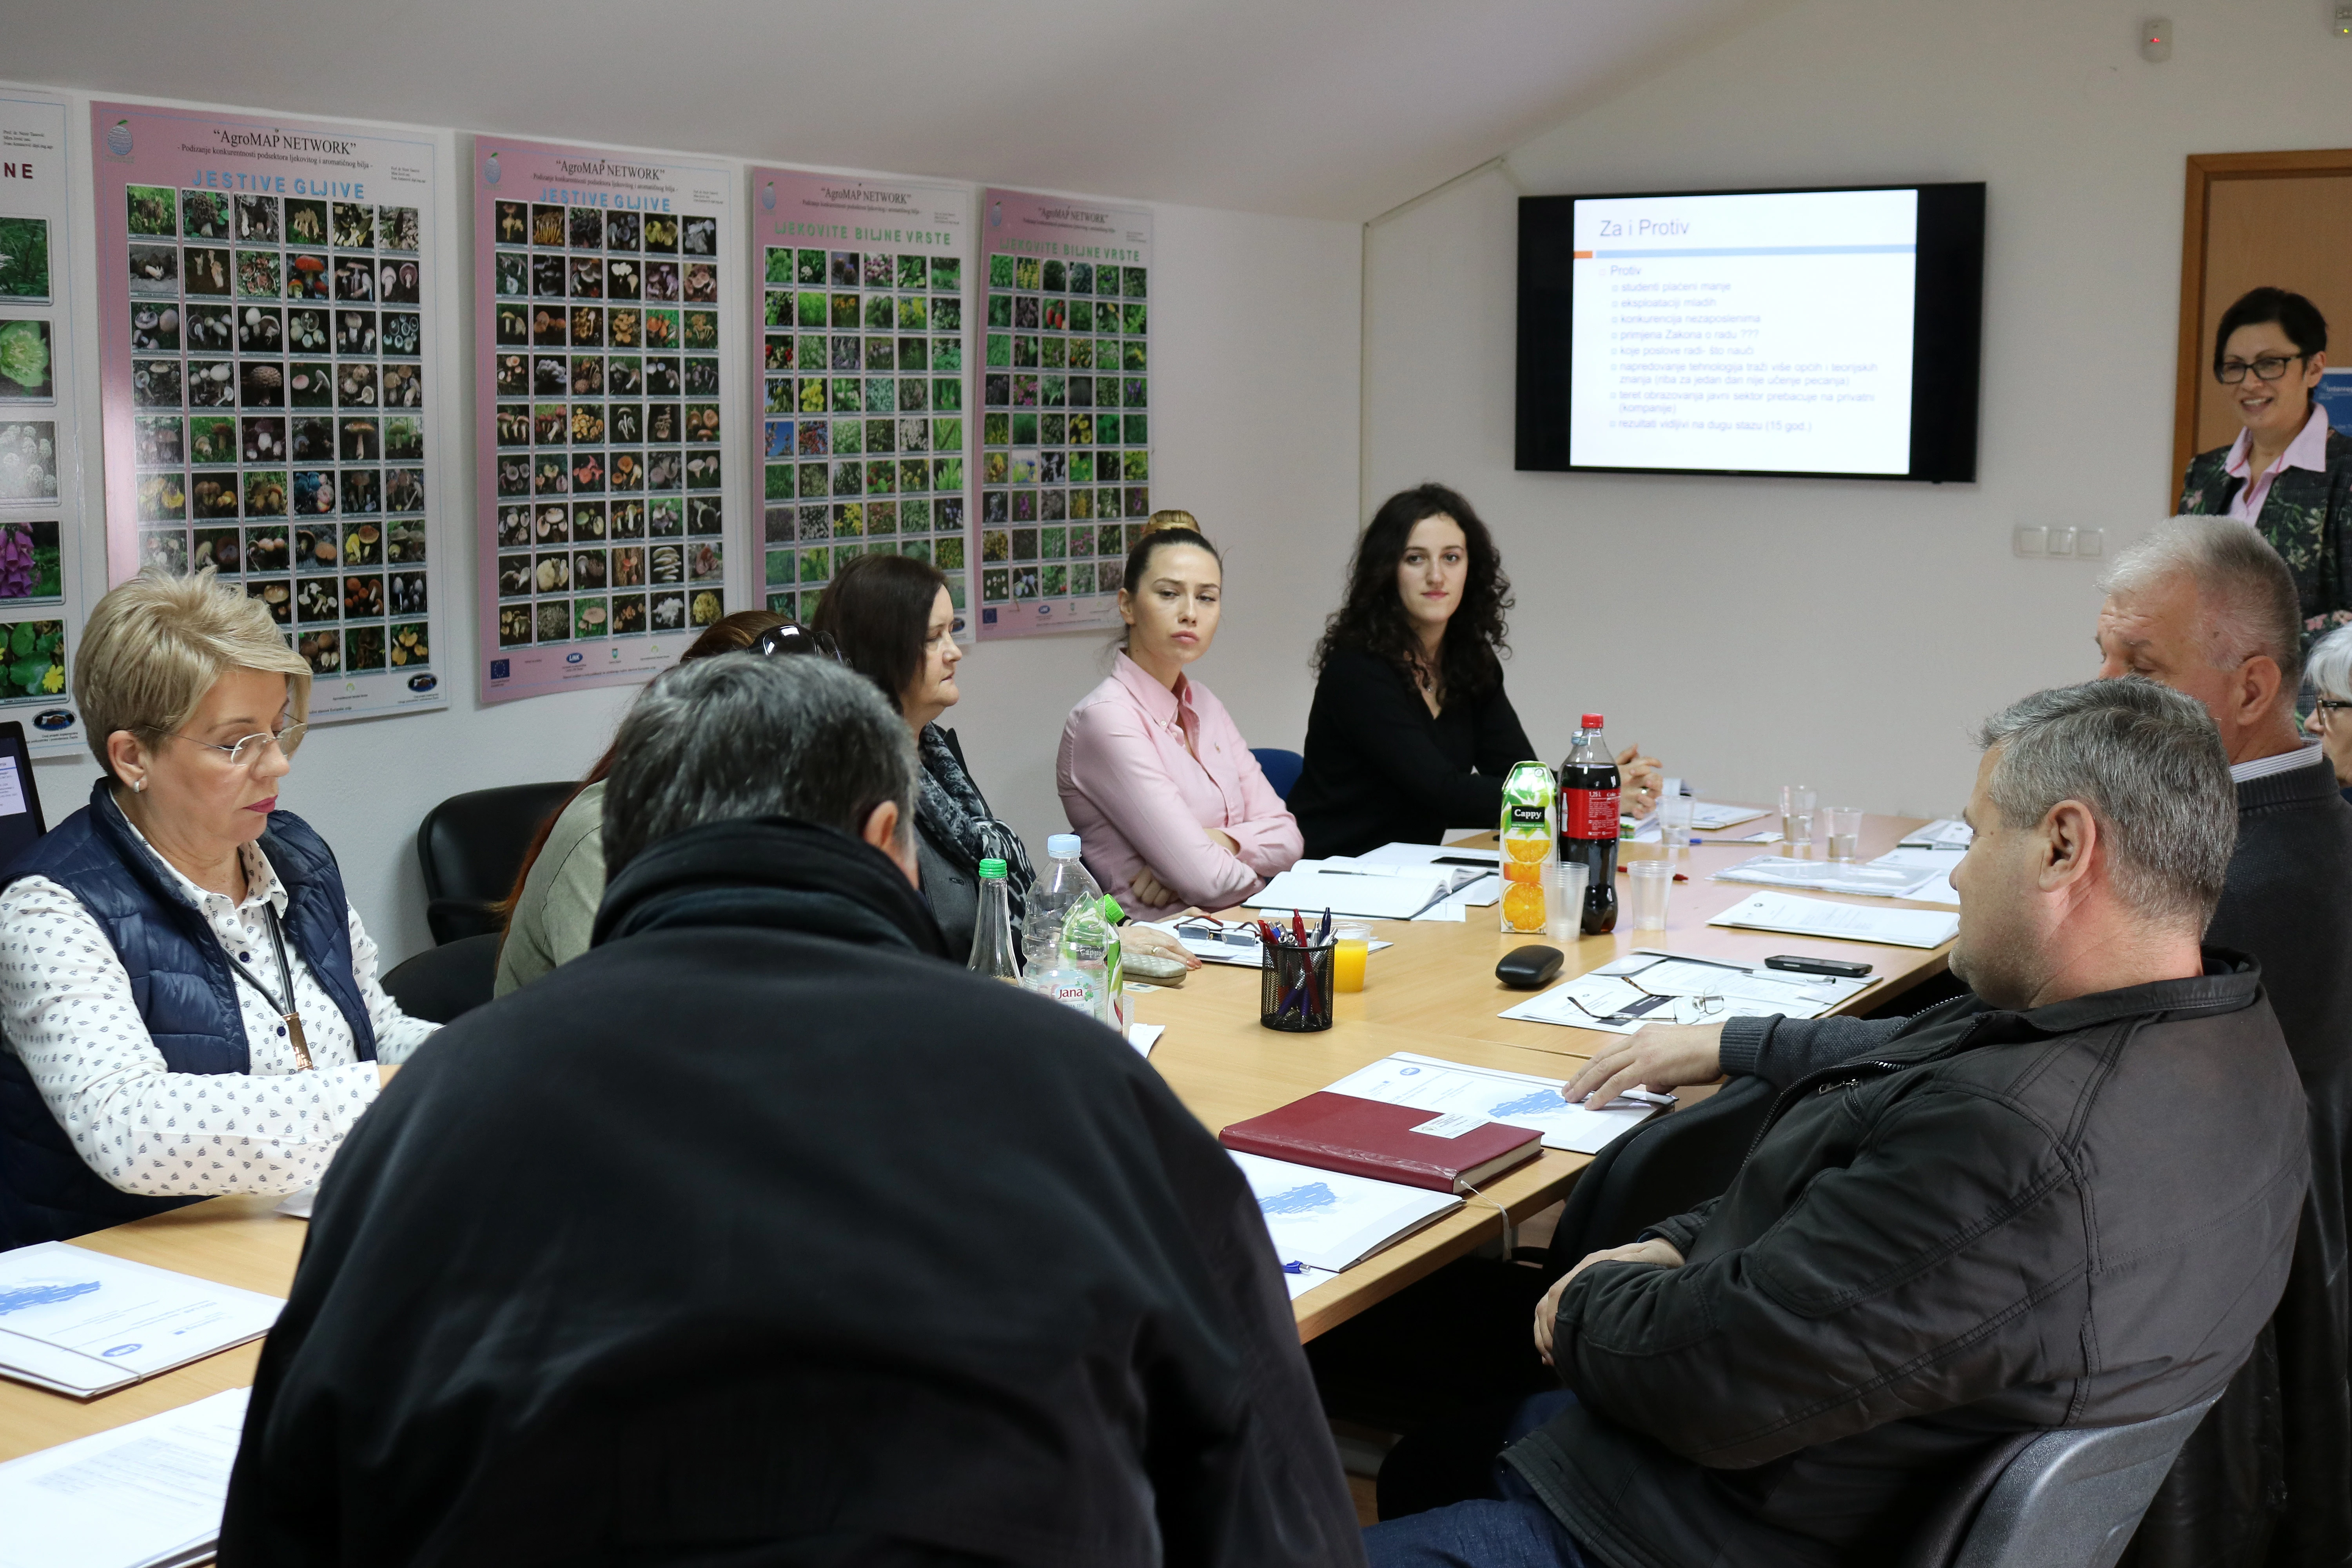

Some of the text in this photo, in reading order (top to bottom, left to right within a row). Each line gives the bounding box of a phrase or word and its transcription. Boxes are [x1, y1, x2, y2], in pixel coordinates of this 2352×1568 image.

[181, 144, 211, 155] Podizanje
[213, 147, 256, 157] konkurentnosti
[257, 152, 288, 160] podsektora
[290, 154, 318, 165] ljekovitog
[323, 159, 356, 168] aromatičnog
[357, 161, 369, 169] bilja
[192, 169, 364, 199] JESTIVE GLJIVE
[539, 188, 608, 208] JESTIVE
[613, 194, 671, 212] GLJIVE
[1600, 218, 1690, 238] Za i Protiv
[855, 227, 901, 242] BILJNE
[906, 230, 951, 245] VRSTE
[1063, 243, 1100, 258] BILJNE
[1104, 247, 1140, 262] VRSTE
[1610, 265, 1642, 276] Protiv
[1621, 281, 1731, 293] studenti plaćeni manje
[1683, 298, 1717, 307] mladih
[1621, 314, 1761, 325] konkurencija nezaposlenima
[1620, 330, 1662, 341] primjena
[1665, 329, 1702, 339] Zakona
[1714, 330, 1737, 339] radu
[1740, 329, 1760, 339] ???
[1620, 347, 1640, 357] koje
[1642, 347, 1681, 357] poslove
[1709, 346, 1724, 355] što
[1619, 362, 1686, 372] napredovanje
[1689, 361, 1743, 373] tehnologija
[1771, 361, 1792, 371] više
[1619, 376, 1651, 385] znanja
[1679, 376, 1691, 384] za
[1693, 375, 1722, 386] jedan
[1725, 375, 1744, 384] dan
[1746, 375, 1764, 386] nije
[1768, 375, 1802, 387] učenje
[1619, 390, 1642, 399] teret
[1643, 390, 1704, 402] obrazovanja
[1733, 391, 1764, 400] sektor
[1766, 392, 1818, 403] prebacuje
[1692, 421, 1704, 429] na
[1707, 420, 1732, 432] dugu
[1735, 420, 1762, 430] stazu
[1766, 419, 1782, 432] (15
[1784, 420, 1813, 433] god.)
[1514, 809, 1542, 820] Cappy
